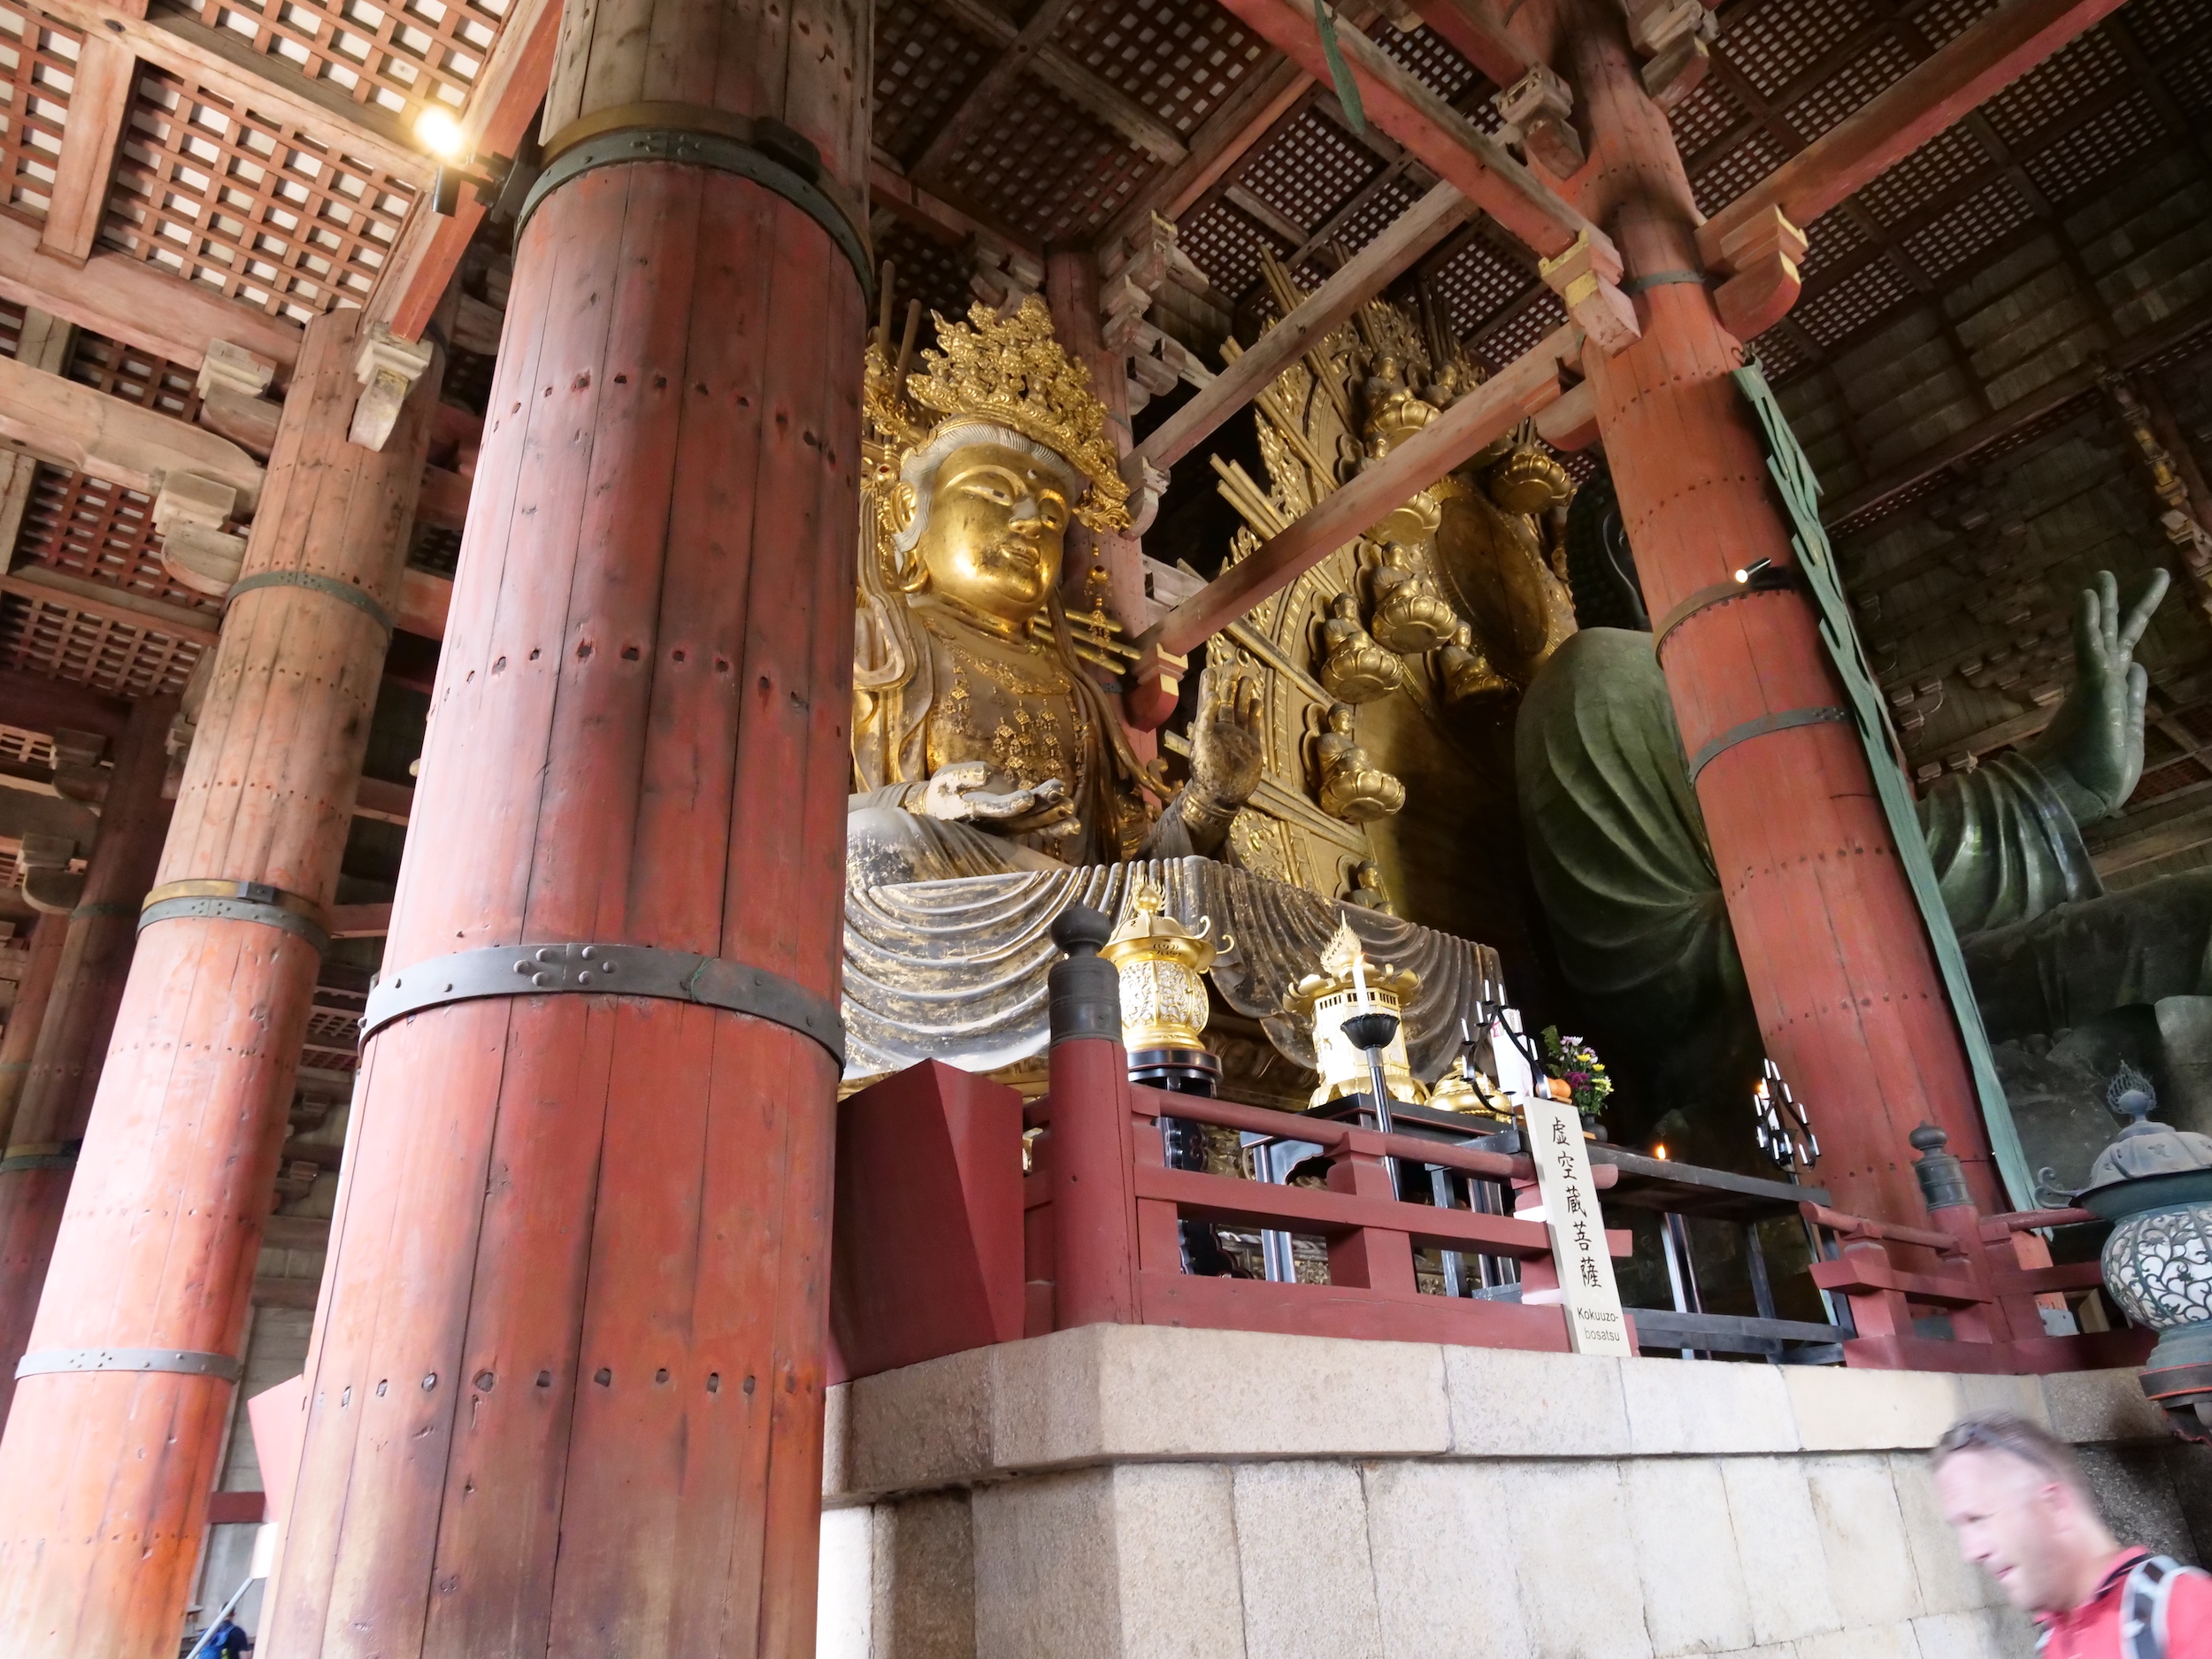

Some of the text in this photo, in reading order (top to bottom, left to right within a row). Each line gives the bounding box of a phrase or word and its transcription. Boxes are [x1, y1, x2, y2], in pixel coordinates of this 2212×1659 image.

[1551, 1116, 1602, 1288] 虚空蔵菩薩
[1577, 1307, 1618, 1323] Kokuuzo-
[1583, 1326, 1620, 1341] bosatsu
